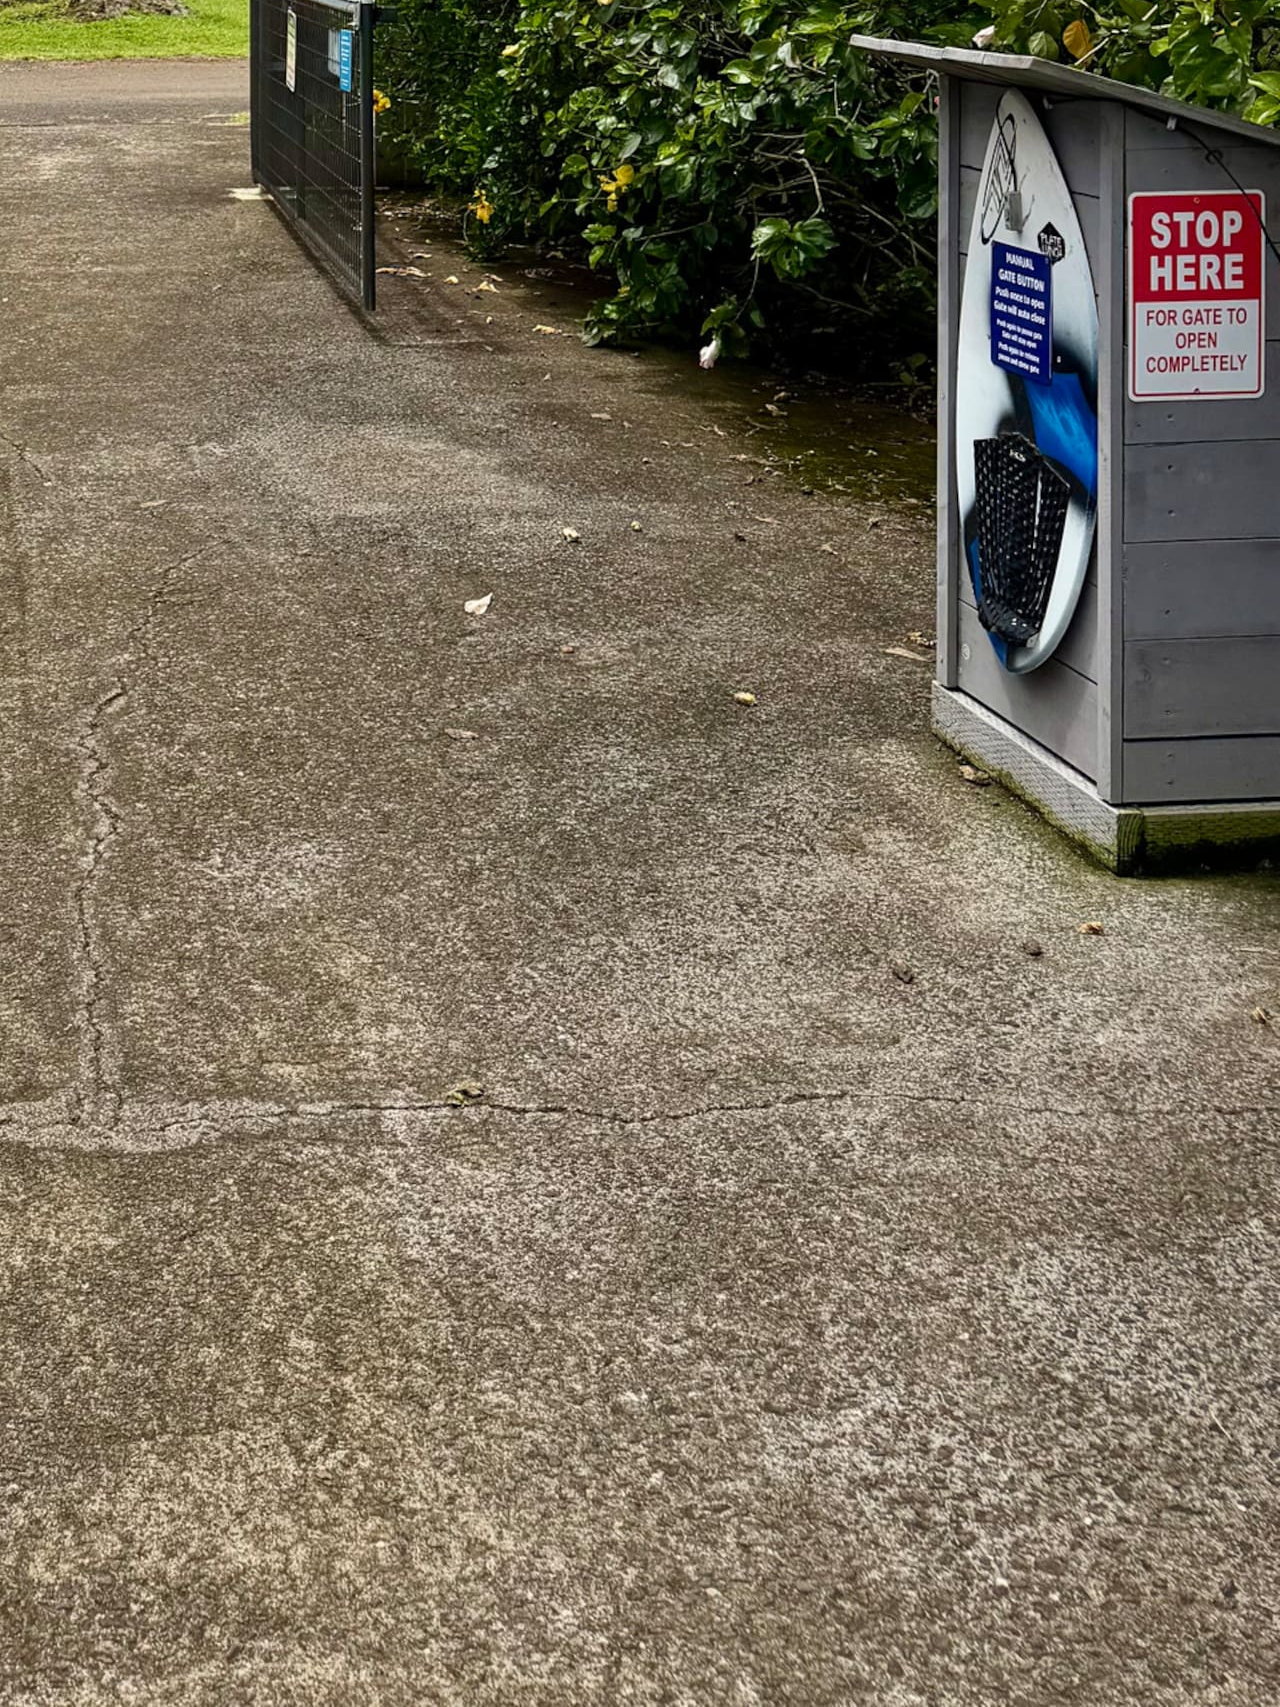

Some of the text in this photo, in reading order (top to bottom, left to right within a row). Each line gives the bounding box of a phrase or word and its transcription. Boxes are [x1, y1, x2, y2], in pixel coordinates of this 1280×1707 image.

[1150, 210, 1243, 249] STOP
[1040, 233, 1062, 248] PLATE
[1006, 252, 1035, 271] MANUAL
[998, 268, 1045, 292] GATE BUTTON
[1150, 253, 1244, 292] HERE
[995, 286, 1045, 310] Push once to open
[994, 300, 1045, 325] Gate will auto close
[1146, 308, 1247, 326] FOR GATE TO
[1175, 332, 1217, 349] OPEN
[1146, 354, 1248, 373] COMPLETELY
